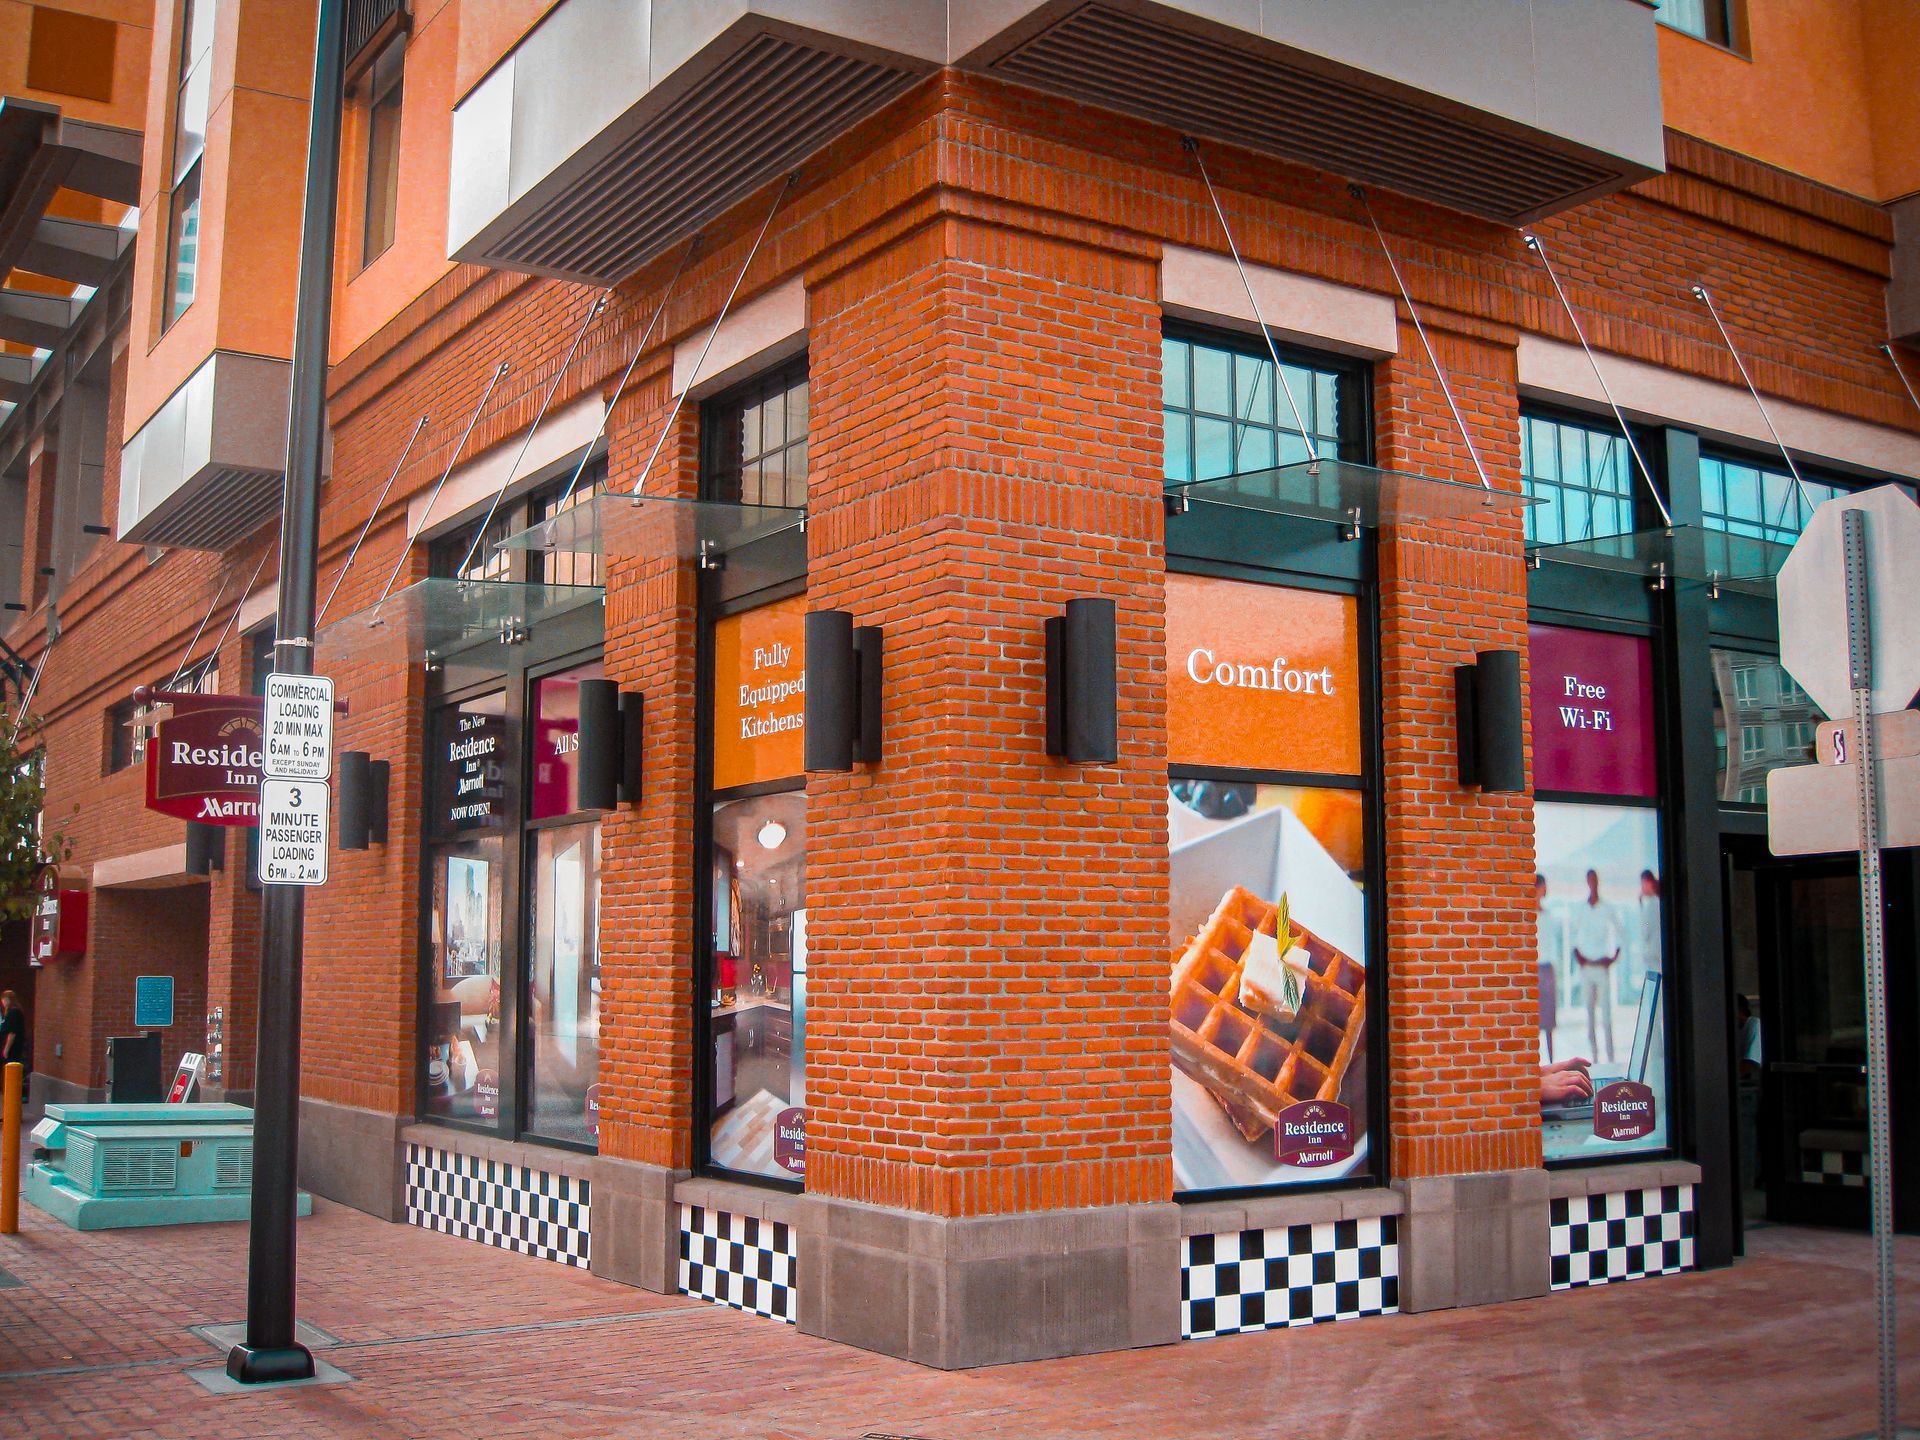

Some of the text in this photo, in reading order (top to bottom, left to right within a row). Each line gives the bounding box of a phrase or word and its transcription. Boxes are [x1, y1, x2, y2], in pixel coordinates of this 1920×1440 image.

[753, 643, 791, 670] Fully
[1185, 646, 1334, 696] Comfort
[270, 684, 329, 702] COMMERCIAL
[739, 671, 806, 708] Equipped
[1563, 675, 1606, 700] Free
[279, 702, 319, 718] LOADING
[460, 715, 486, 732] The New
[741, 712, 804, 739] Kitchens
[1558, 706, 1613, 732] Wi-Fi
[273, 721, 323, 738] 20 MIN MAX
[270, 738, 277, 754] 6
[278, 743, 290, 756] AM
[303, 742, 309, 757] 6
[312, 746, 324, 758] PM
[449, 736, 495, 762] Residence
[554, 733, 579, 755] All S
[171, 741, 263, 768] Reside
[272, 758, 321, 768] EXCEPT SUNDAY
[226, 770, 258, 785] Inn
[458, 774, 484, 796] Marriott
[289, 787, 302, 807] 3
[197, 797, 261, 817] Marri
[450, 801, 491, 821] NOW OPEN!
[271, 812, 318, 827] MINUTE
[266, 828, 322, 844] PASSENGER
[272, 846, 314, 861] LOADING
[268, 863, 274, 878] 6
[276, 867, 287, 879] PM
[298, 864, 304, 879] 2
[306, 868, 319, 879] AM
[1601, 1100, 1648, 1113] Residence
[780, 1125, 807, 1142] Reside
[1285, 1120, 1344, 1136] Residence
[1611, 1125, 1640, 1138] Marriott
[1307, 1136, 1322, 1144] Inn
[1296, 1150, 1333, 1164] Marriott
